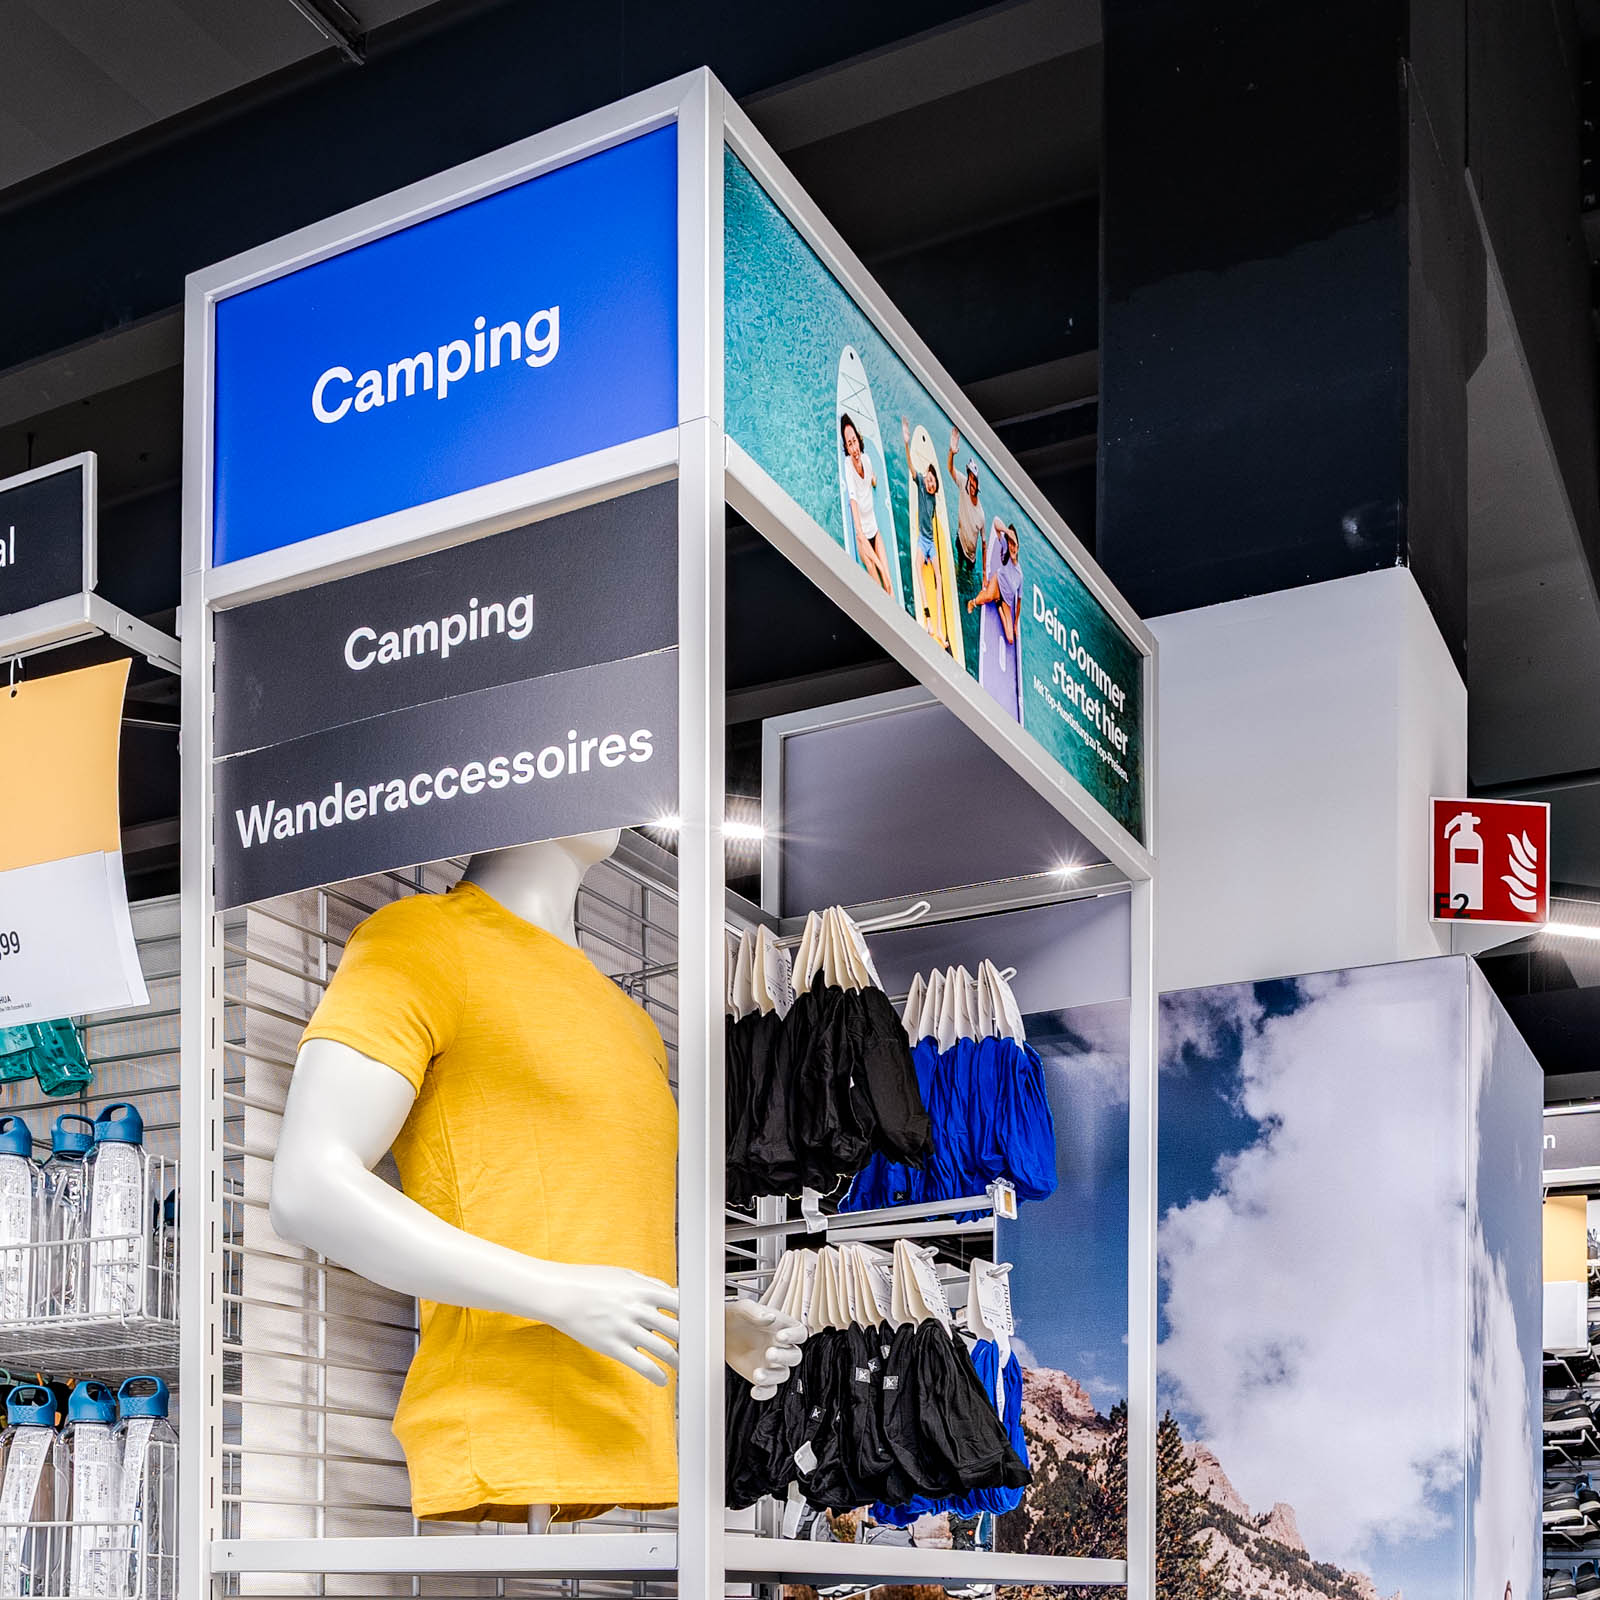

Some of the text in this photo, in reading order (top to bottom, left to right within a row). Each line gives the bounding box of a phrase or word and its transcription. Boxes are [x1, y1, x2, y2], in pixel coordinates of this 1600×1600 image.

[311, 304, 561, 425] Camping
[342, 592, 535, 672] Camping
[1033, 584, 1126, 713] Dein Sommer
[1052, 660, 1129, 756] startet hier
[234, 728, 654, 849] Wanderaccessoires
